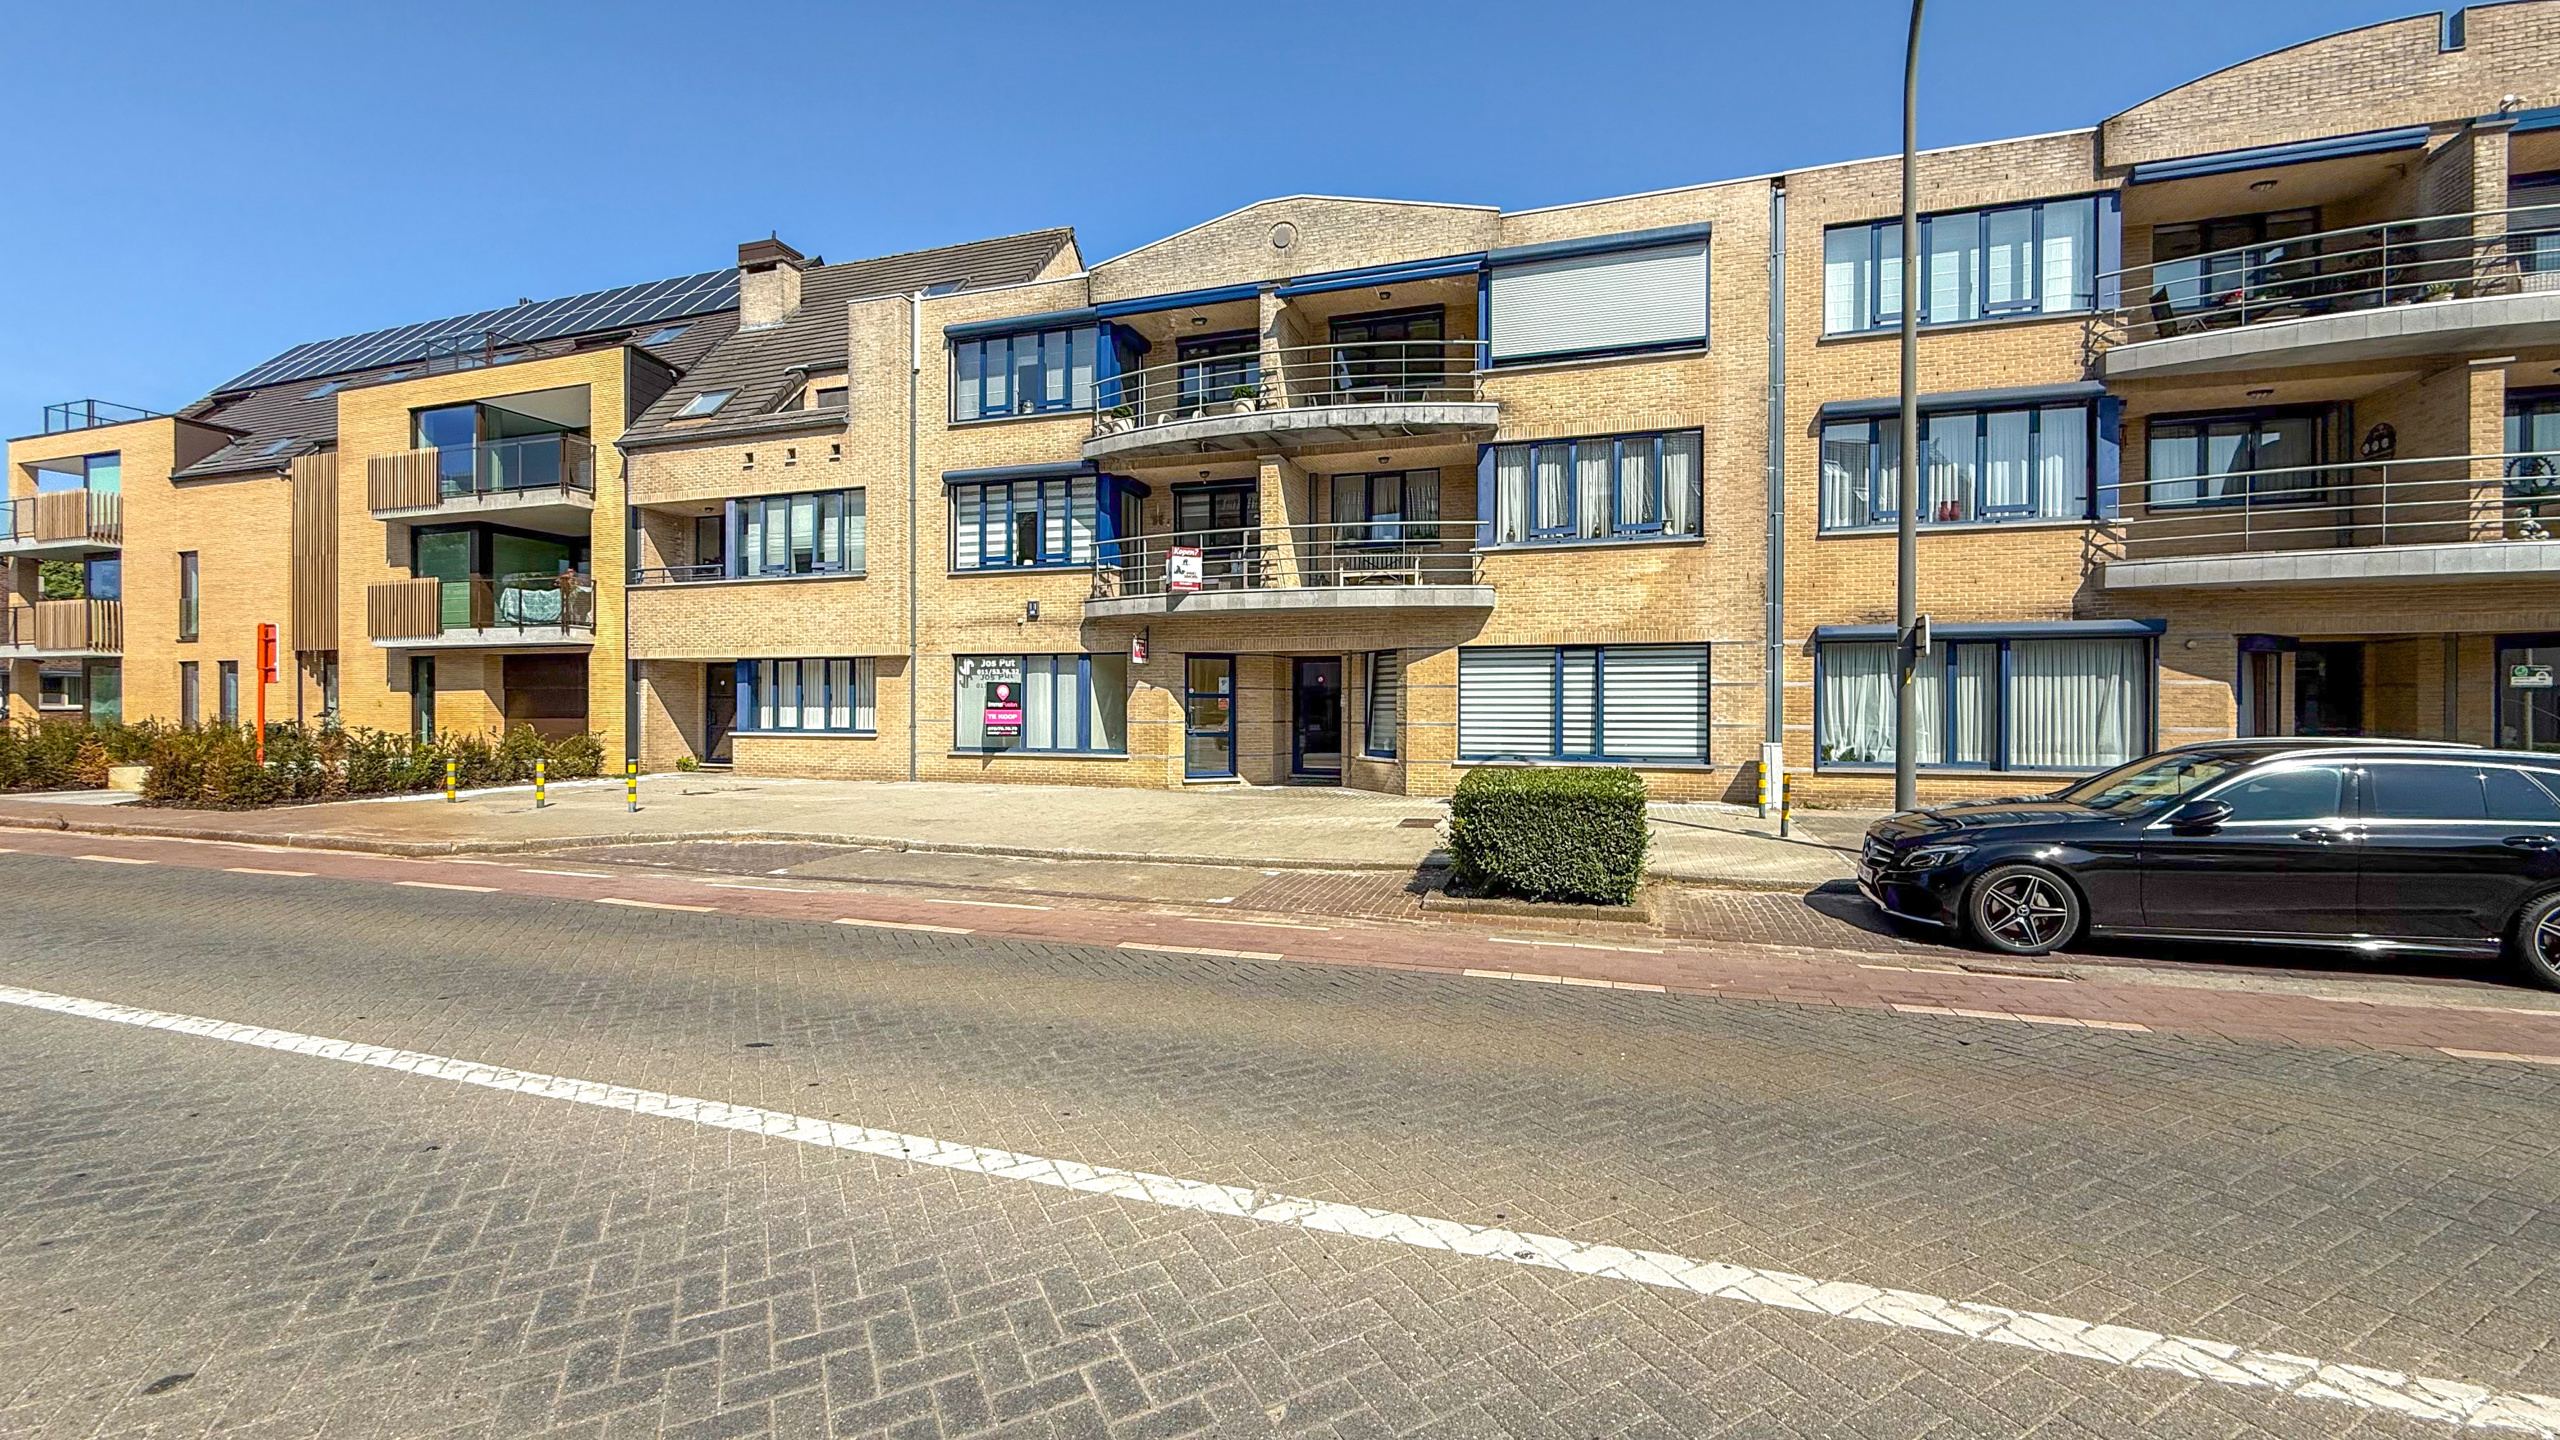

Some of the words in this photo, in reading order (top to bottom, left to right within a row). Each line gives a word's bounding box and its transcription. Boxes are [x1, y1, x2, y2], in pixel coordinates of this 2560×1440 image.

[1173, 547, 1199, 556] Kopen?
[981, 659, 997, 667] Jos
[999, 659, 1015, 667] Put
